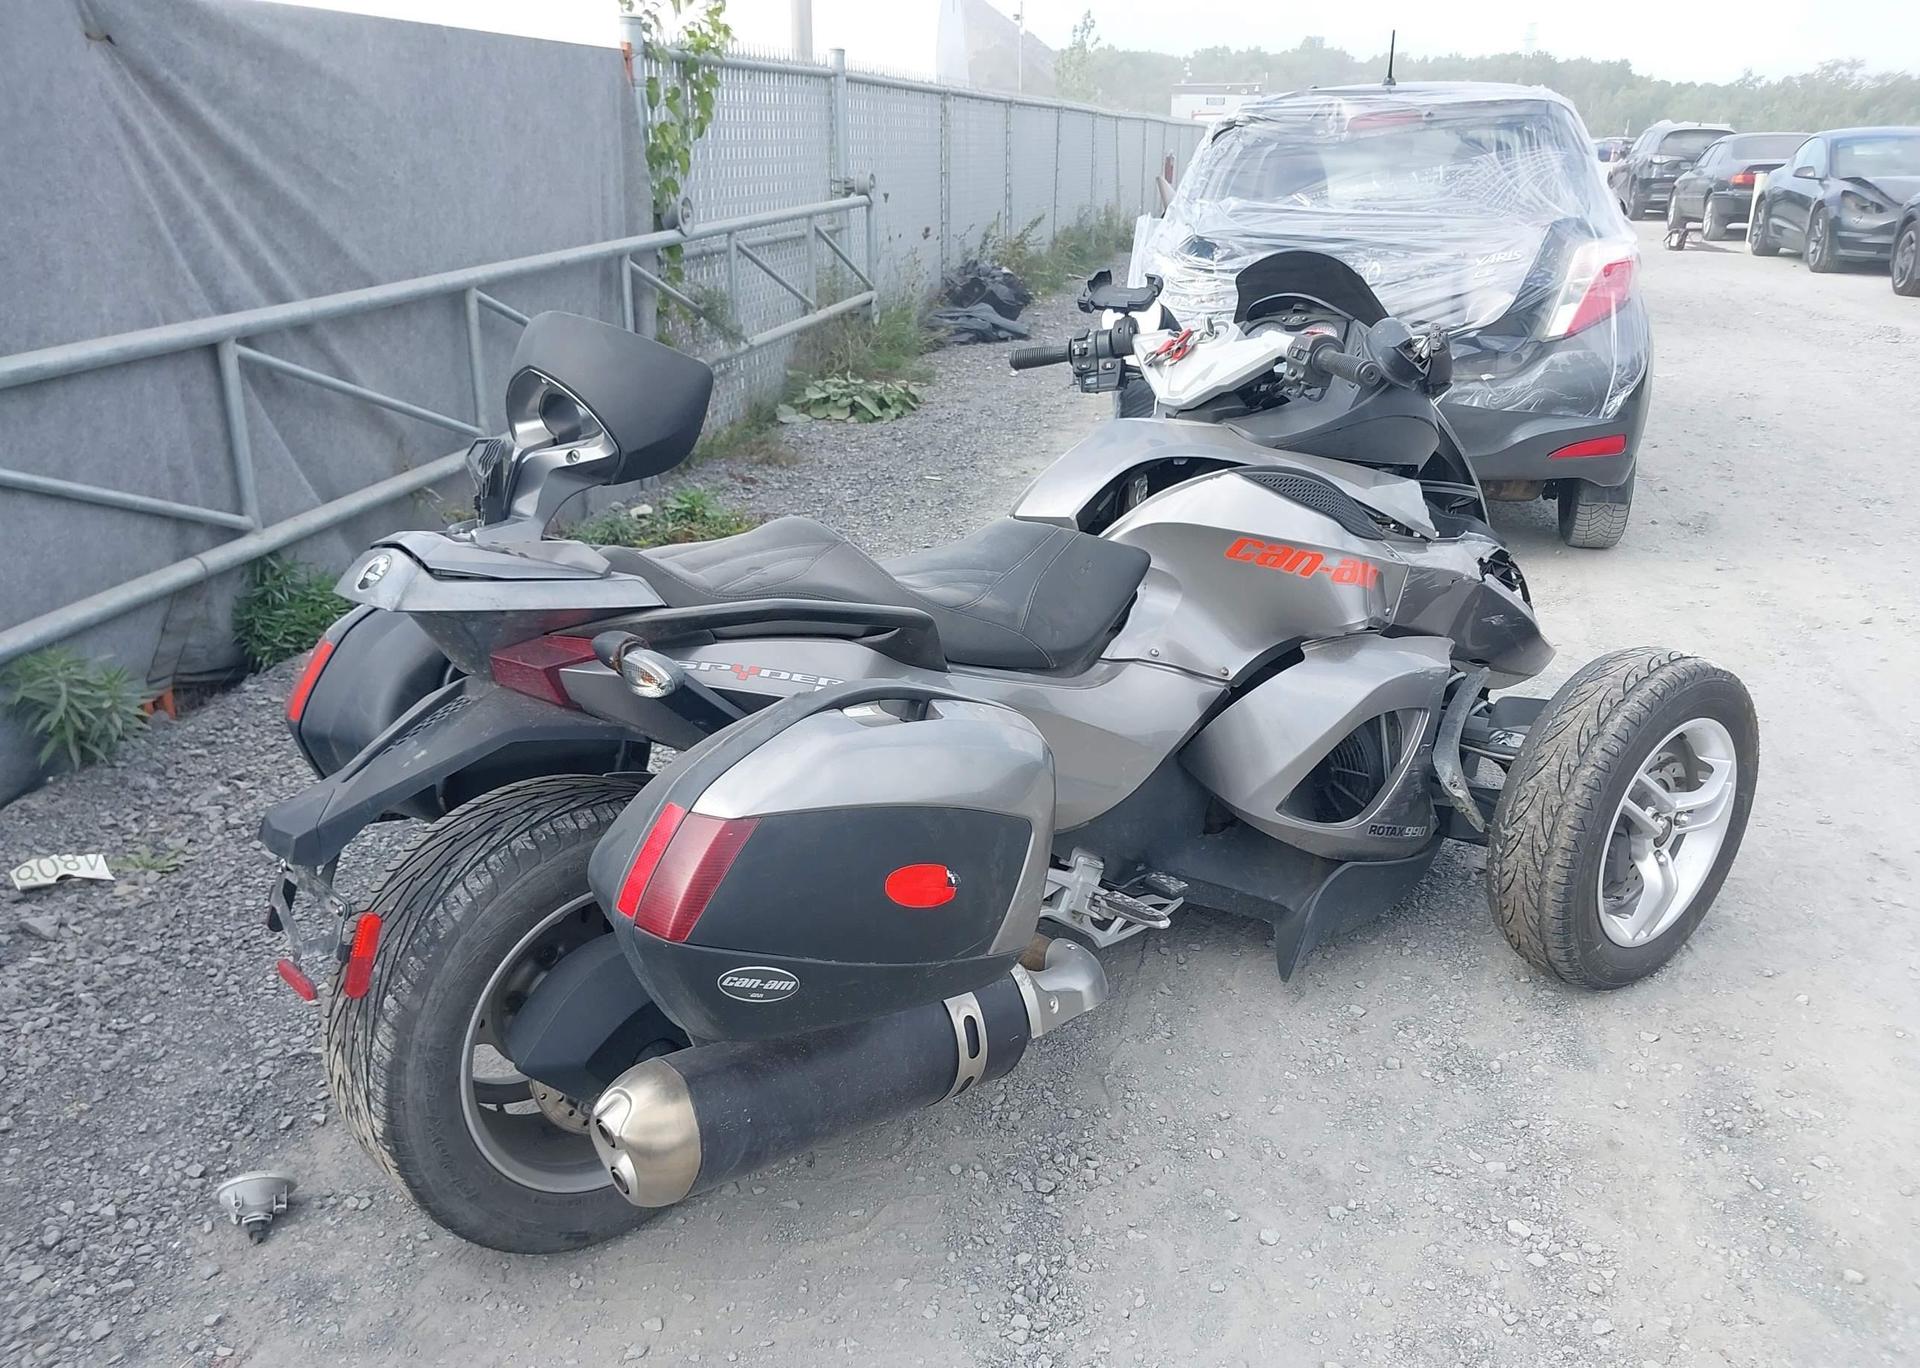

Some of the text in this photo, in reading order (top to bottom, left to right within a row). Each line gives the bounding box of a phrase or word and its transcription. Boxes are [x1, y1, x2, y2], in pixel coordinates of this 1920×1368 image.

[1475, 249, 1523, 266] YARIS
[674, 660, 845, 692] SPYDER
[721, 976, 797, 991] can-am
